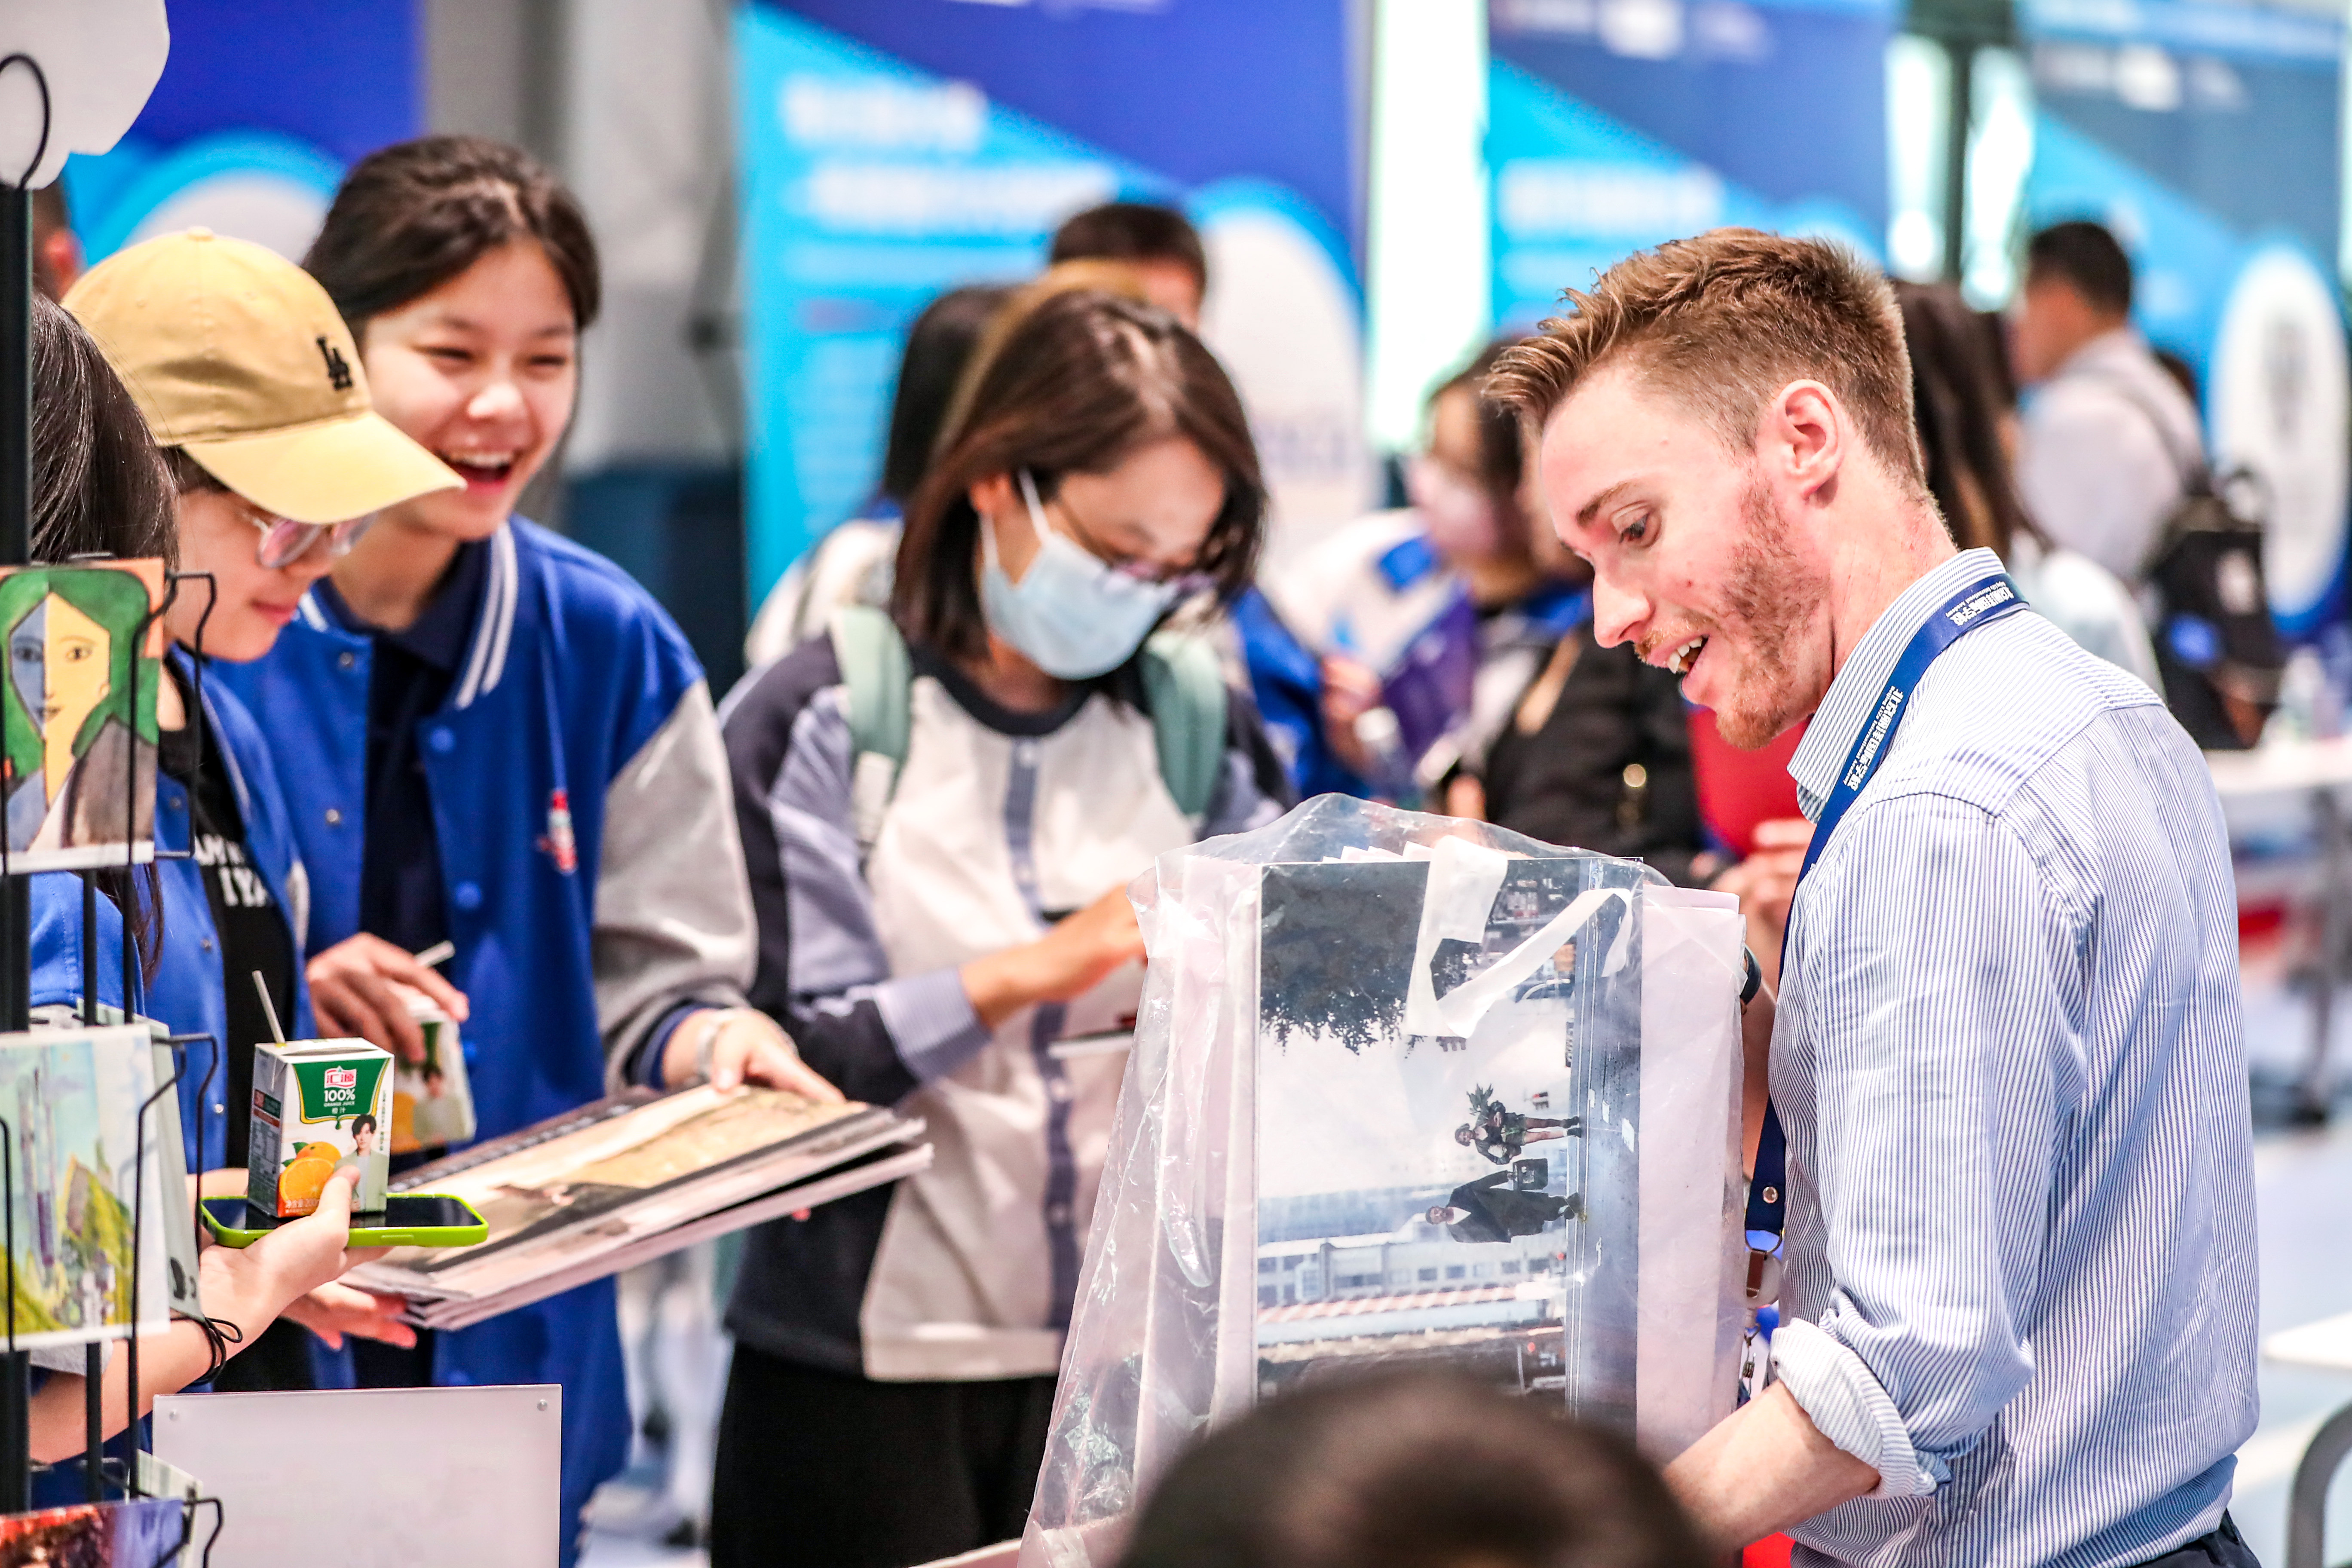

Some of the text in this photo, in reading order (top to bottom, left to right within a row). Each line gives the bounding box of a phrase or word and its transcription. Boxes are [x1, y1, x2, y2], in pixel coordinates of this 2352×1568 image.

[1847, 689, 1903, 791] 北京丽泽国际学校
[1856, 720, 1877, 759] International
[1843, 759, 1857, 785] Academy
[324, 1088, 355, 1102] 100%
